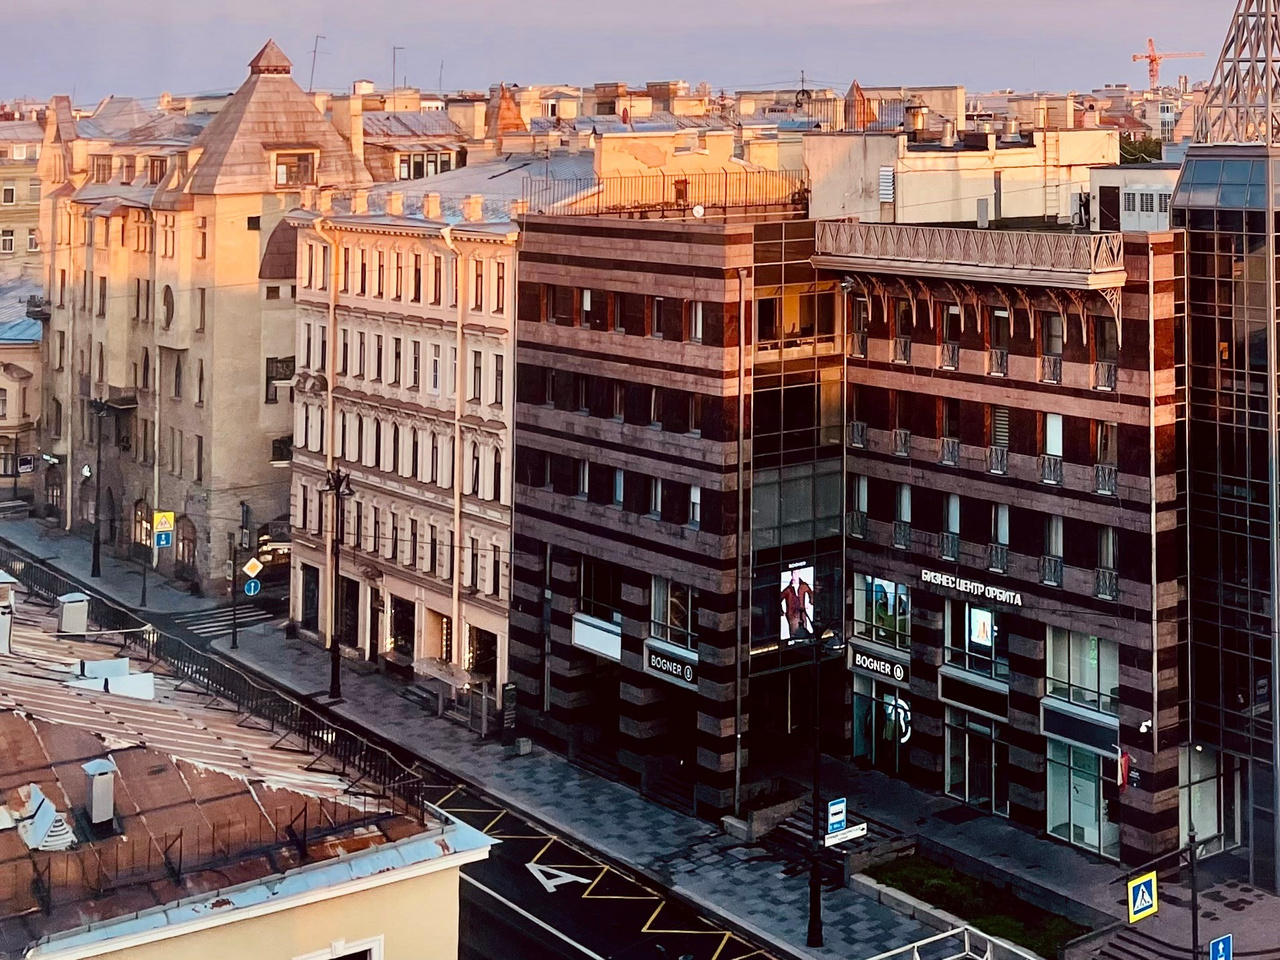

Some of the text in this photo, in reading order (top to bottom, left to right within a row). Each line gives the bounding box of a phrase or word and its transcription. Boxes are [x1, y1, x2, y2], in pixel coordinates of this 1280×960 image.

[921, 569, 1022, 606] БИЗНЕС ЦЕНТР ОРБИТА
[651, 655, 682, 675] BOGNER
[855, 653, 891, 675] BOGNER
